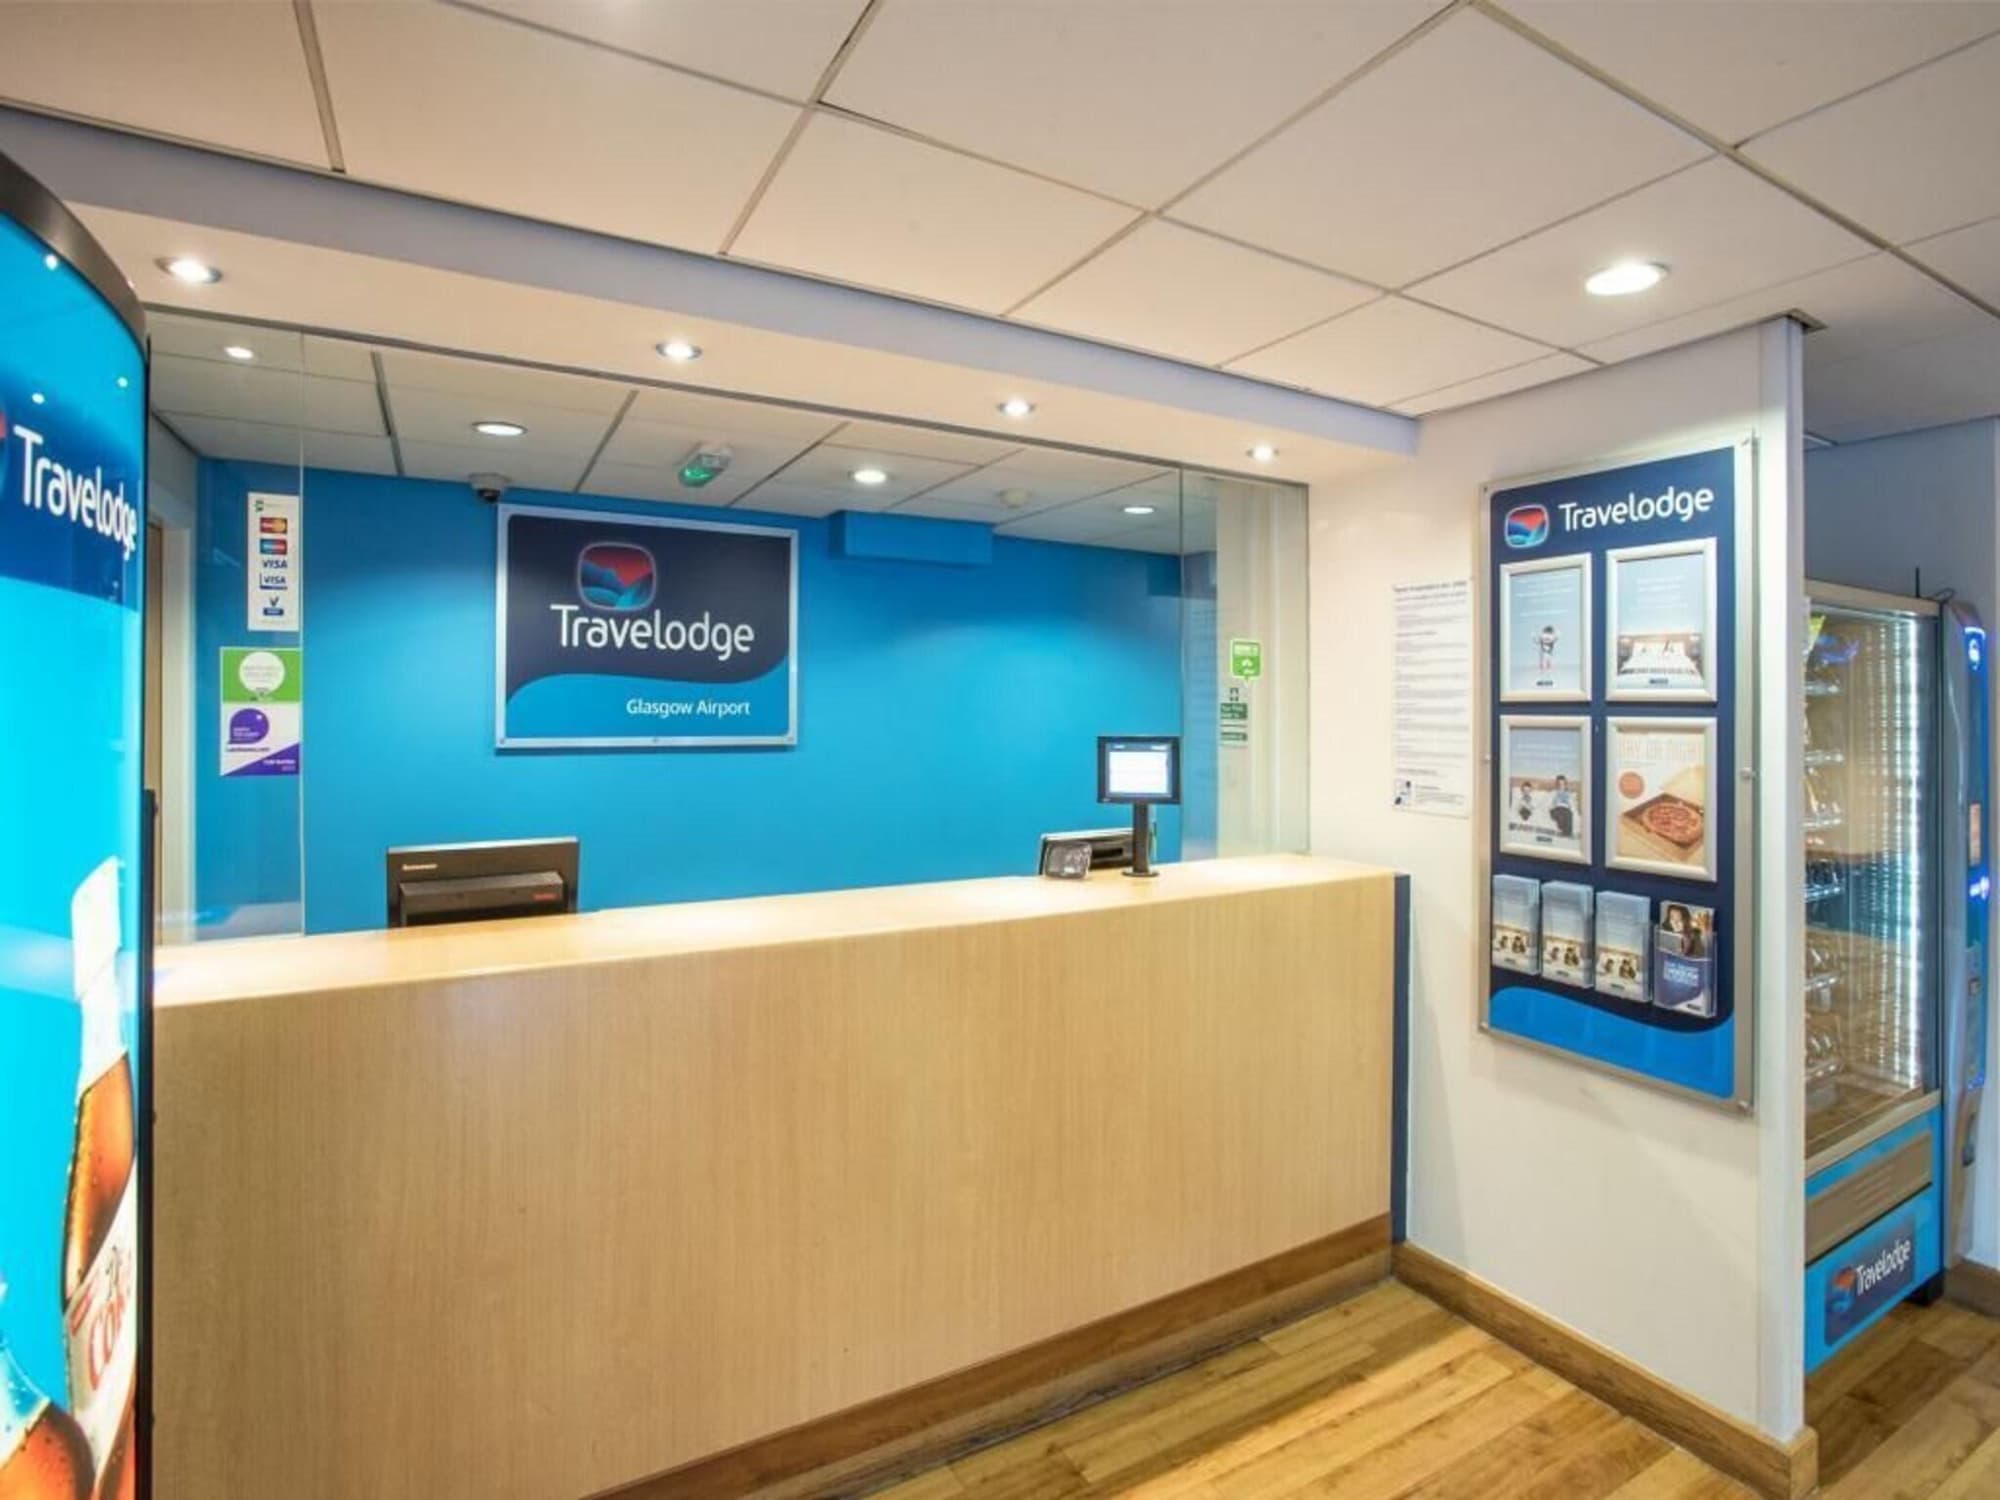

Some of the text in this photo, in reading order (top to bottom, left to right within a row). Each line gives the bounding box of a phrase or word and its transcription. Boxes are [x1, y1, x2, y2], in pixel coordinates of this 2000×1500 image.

[13, 424, 137, 561] Travelodge
[1558, 485, 1714, 532] Travelodge
[262, 560, 288, 569] VISA
[264, 576, 286, 585] VISA
[550, 604, 755, 661] Travelodge
[626, 699, 751, 719] Glasgow Airport
[1855, 1239, 1911, 1296] Travelodge
